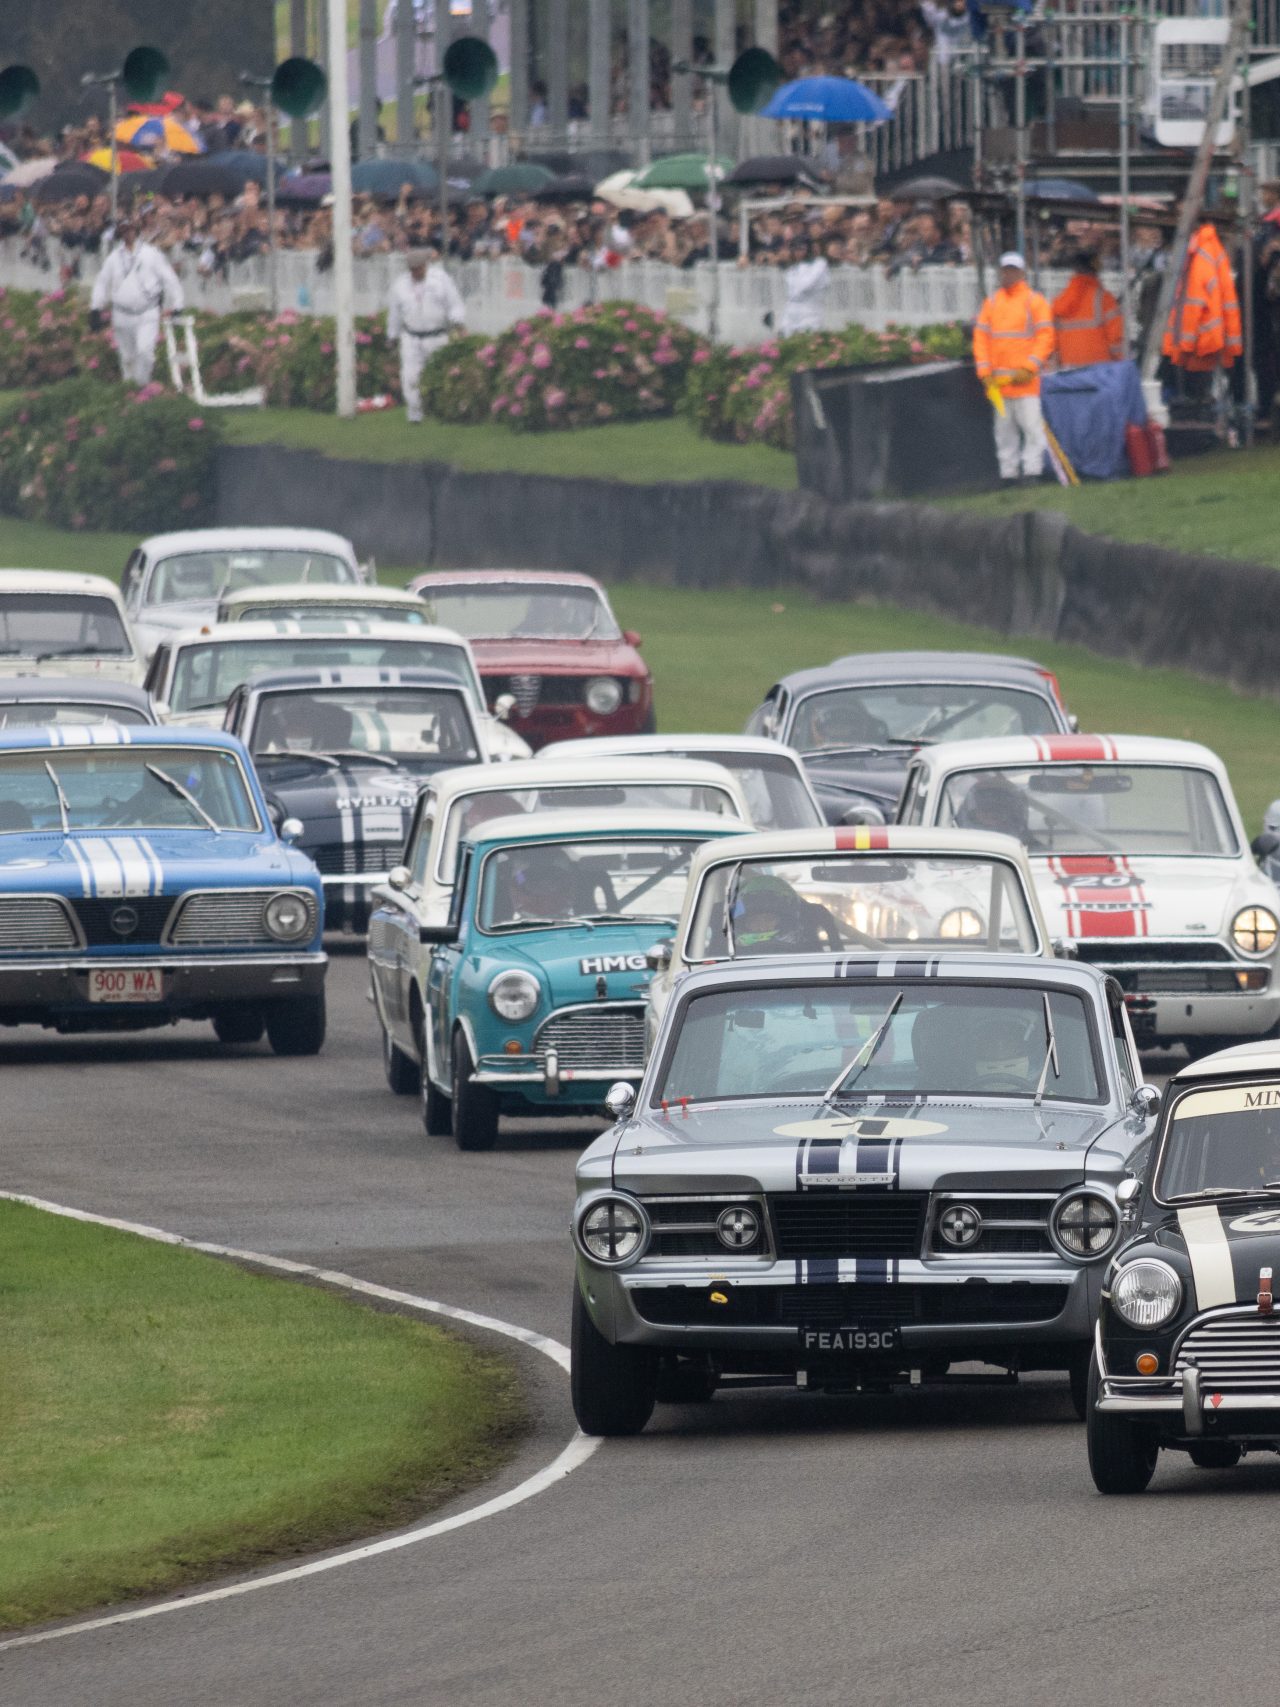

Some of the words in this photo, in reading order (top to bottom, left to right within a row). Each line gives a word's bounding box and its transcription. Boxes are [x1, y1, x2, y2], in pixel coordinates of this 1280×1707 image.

[1071, 876, 1131, 888] 20
[582, 955, 647, 974] HMG
[95, 972, 126, 992] 900
[132, 972, 157, 992] WA
[805, 1332, 894, 1349] FEA193C
